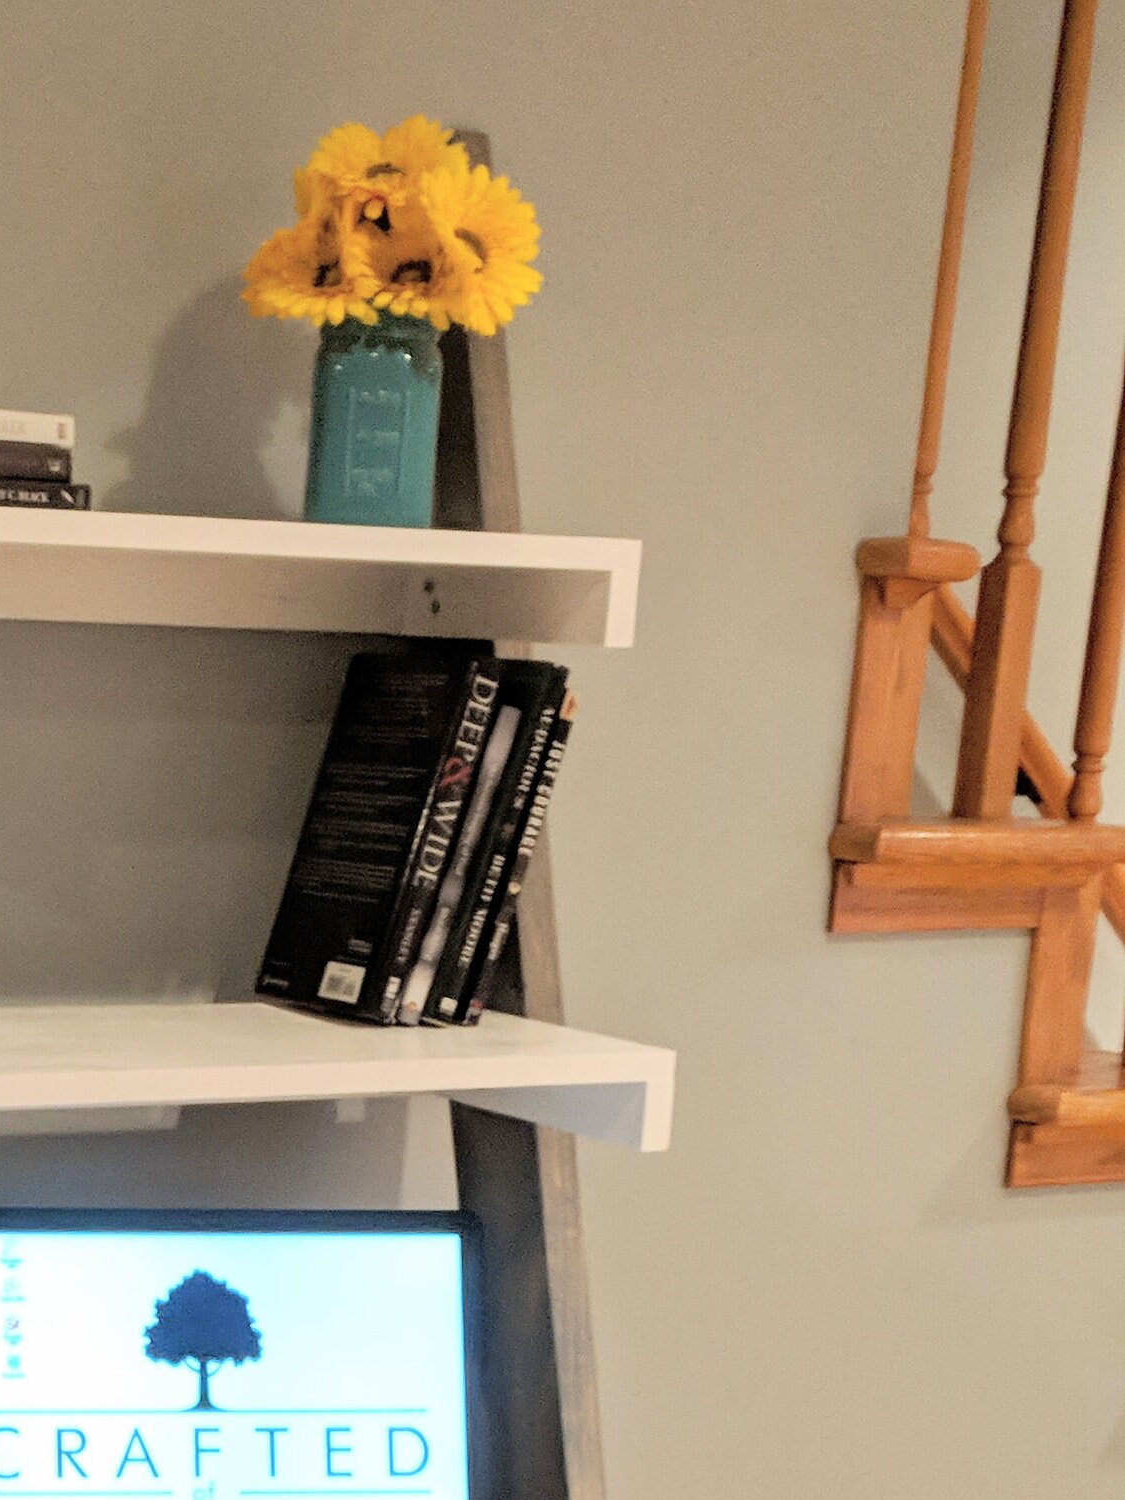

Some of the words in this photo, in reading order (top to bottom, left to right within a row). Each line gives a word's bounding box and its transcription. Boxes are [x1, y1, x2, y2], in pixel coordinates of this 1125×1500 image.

[455, 674, 499, 762] DEEP
[440, 756, 473, 794] &
[414, 800, 463, 890] WIDE
